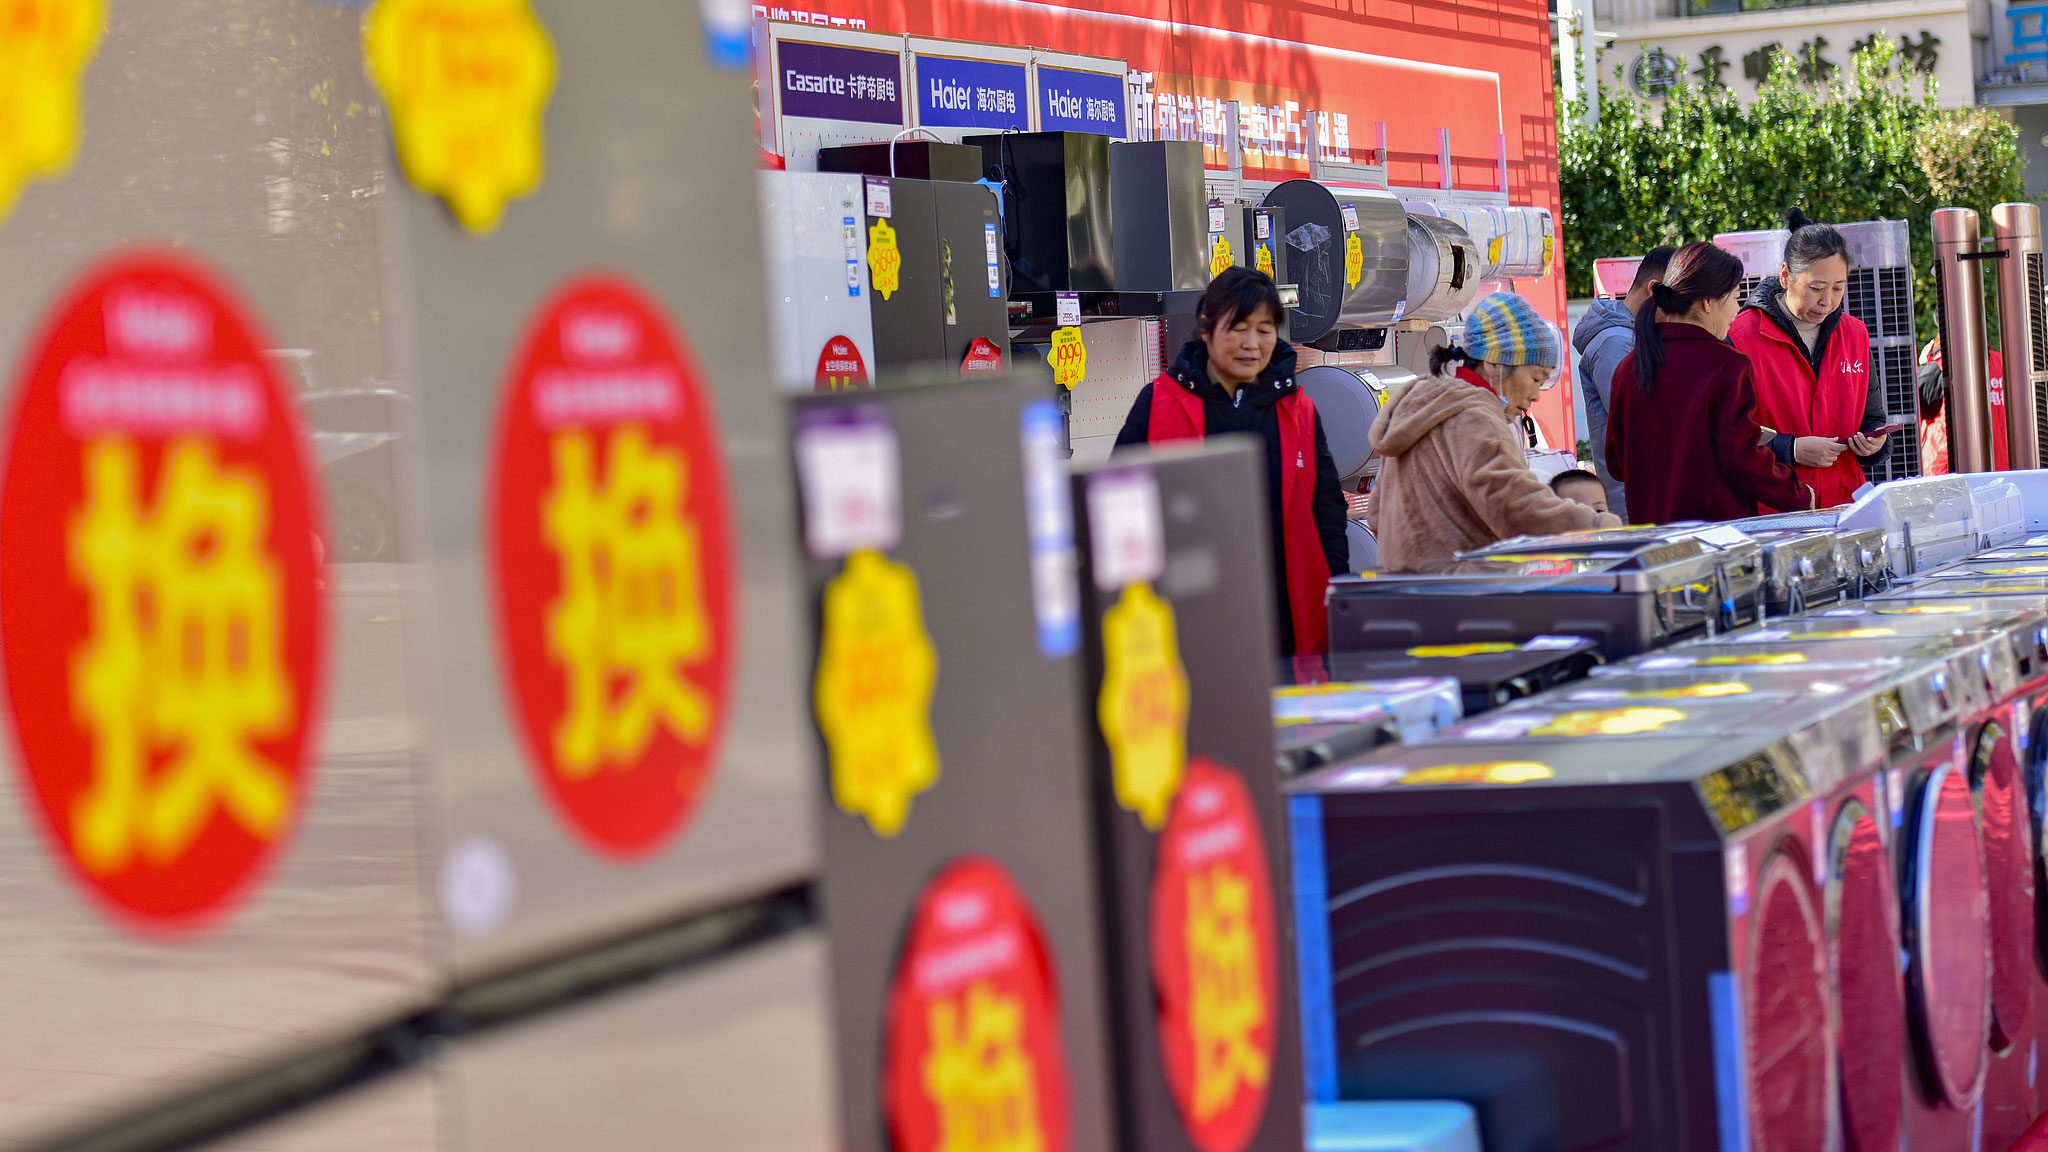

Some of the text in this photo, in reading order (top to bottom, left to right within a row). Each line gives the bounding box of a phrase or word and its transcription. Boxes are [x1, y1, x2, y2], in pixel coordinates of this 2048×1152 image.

[786, 69, 896, 101] Casarte 卡萨帝厨电
[930, 78, 1016, 114] Haier 海尔厨电
[1048, 88, 1117, 123] Haier 海尔厨电
[832, 344, 849, 356] Haier
[1056, 341, 1082, 367] 1999
[544, 428, 711, 773] 换
[66, 436, 291, 870] 换
[1185, 863, 1269, 1126] 换
